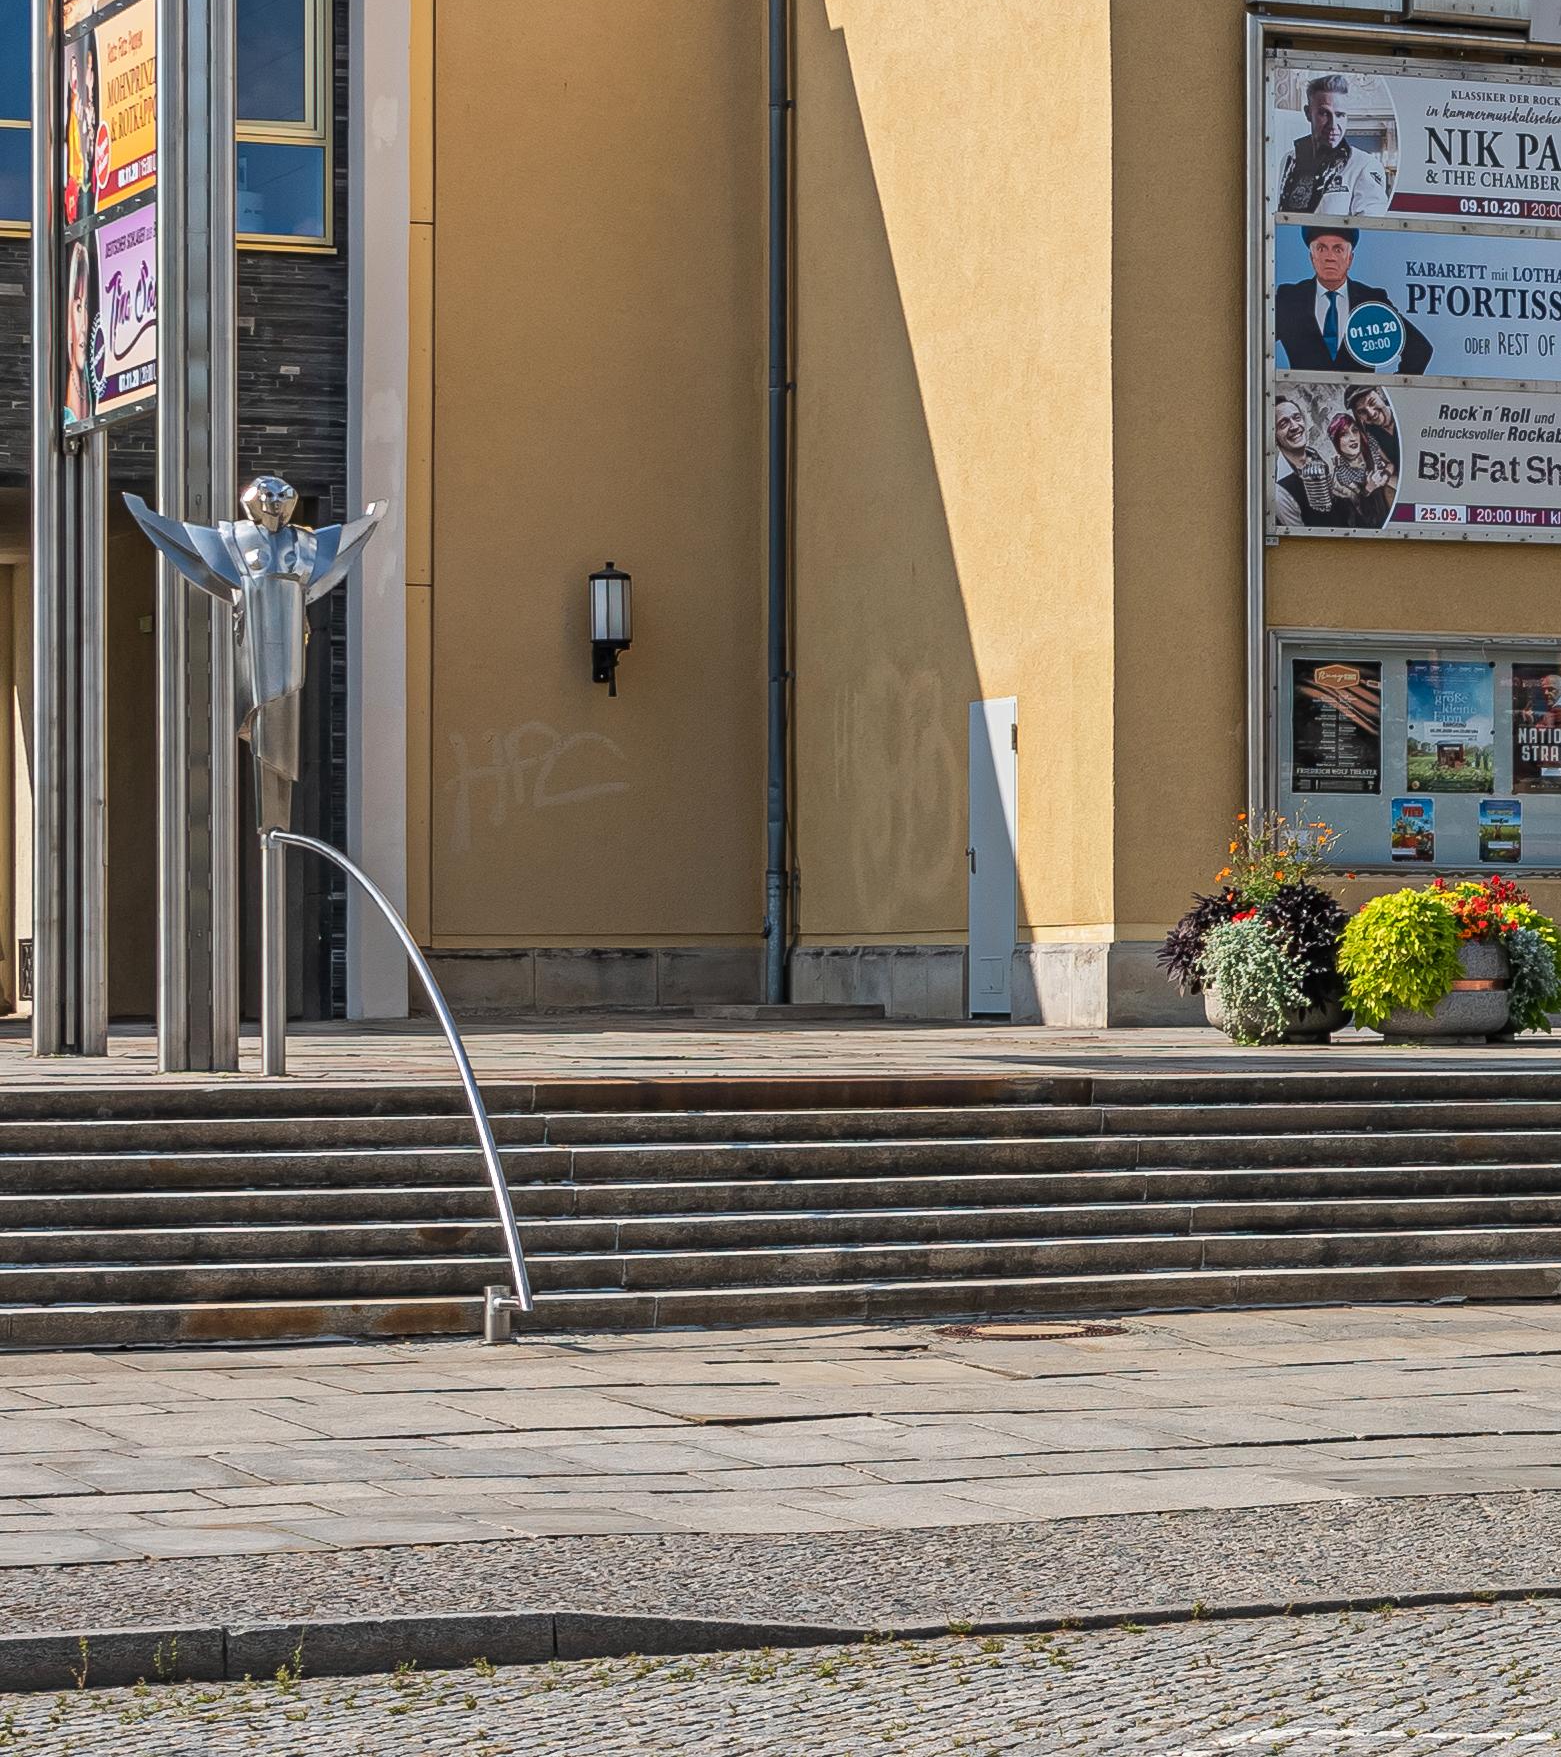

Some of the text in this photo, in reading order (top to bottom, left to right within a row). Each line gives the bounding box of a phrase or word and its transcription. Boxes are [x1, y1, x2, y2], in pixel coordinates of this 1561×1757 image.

[1451, 90, 1506, 104] KLASSIKER
[1509, 94, 1530, 105] DER
[1426, 105, 1439, 117] in
[1424, 126, 1504, 168] NIK
[1425, 169, 1439, 184] &
[1442, 169, 1476, 187] THE
[1480, 172, 1561, 192] CHAMBER
[1460, 199, 1520, 215] 09.10.20
[1405, 261, 1487, 280] KABARETT
[1491, 268, 1508, 281] mit
[1350, 321, 1397, 339] 01.10.20
[1362, 337, 1391, 352] 20:00
[1464, 337, 1490, 355] ODER
[1498, 331, 1530, 356] REST
[1538, 333, 1557, 356] OF
[1534, 413, 1556, 424] und
[1420, 426, 1505, 441] eindrucksvoller
[1418, 450, 1465, 488] Big
[1470, 452, 1521, 484] Fat
[1420, 507, 1462, 522] 25.09.
[1476, 508, 1512, 523] 20:00
[1515, 510, 1536, 524] Uhr
